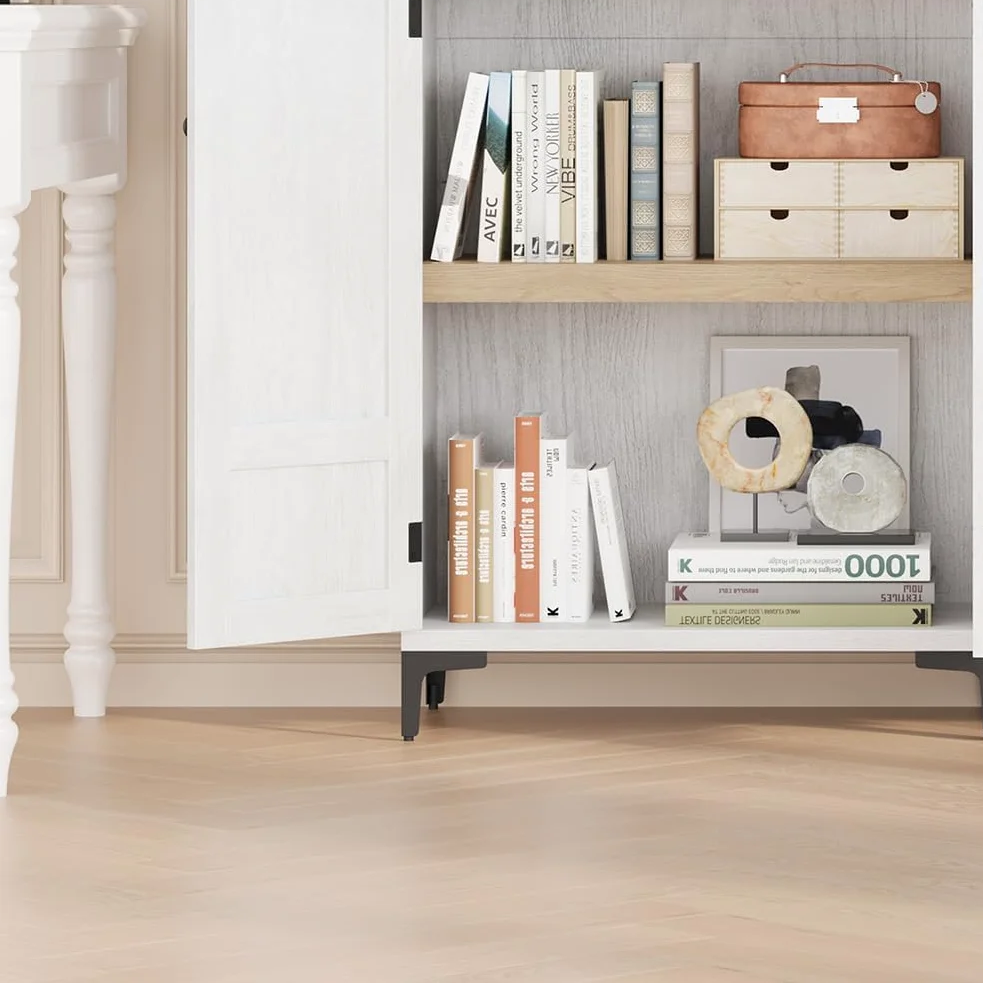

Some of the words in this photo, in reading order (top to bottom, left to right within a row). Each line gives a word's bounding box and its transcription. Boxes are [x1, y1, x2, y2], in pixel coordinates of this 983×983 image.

[546, 112, 560, 163] YORKER
[515, 130, 525, 185] underground
[532, 138, 540, 192] Wrong
[546, 165, 560, 195] NEW
[561, 157, 576, 204] VIBE
[515, 186, 523, 214] velvet
[484, 196, 499, 242] AVEC
[515, 215, 523, 233] the
[698, 566, 709, 574] them
[710, 566, 728, 574] find
[737, 566, 757, 574] where
[758, 566, 770, 574] and
[771, 565, 796, 574] gardens
[796, 566, 808, 574] the
[808, 566, 818, 574] for
[818, 565, 843, 575] designs
[844, 554, 921, 578] 1000
[880, 593, 923, 602] TEXTILES
